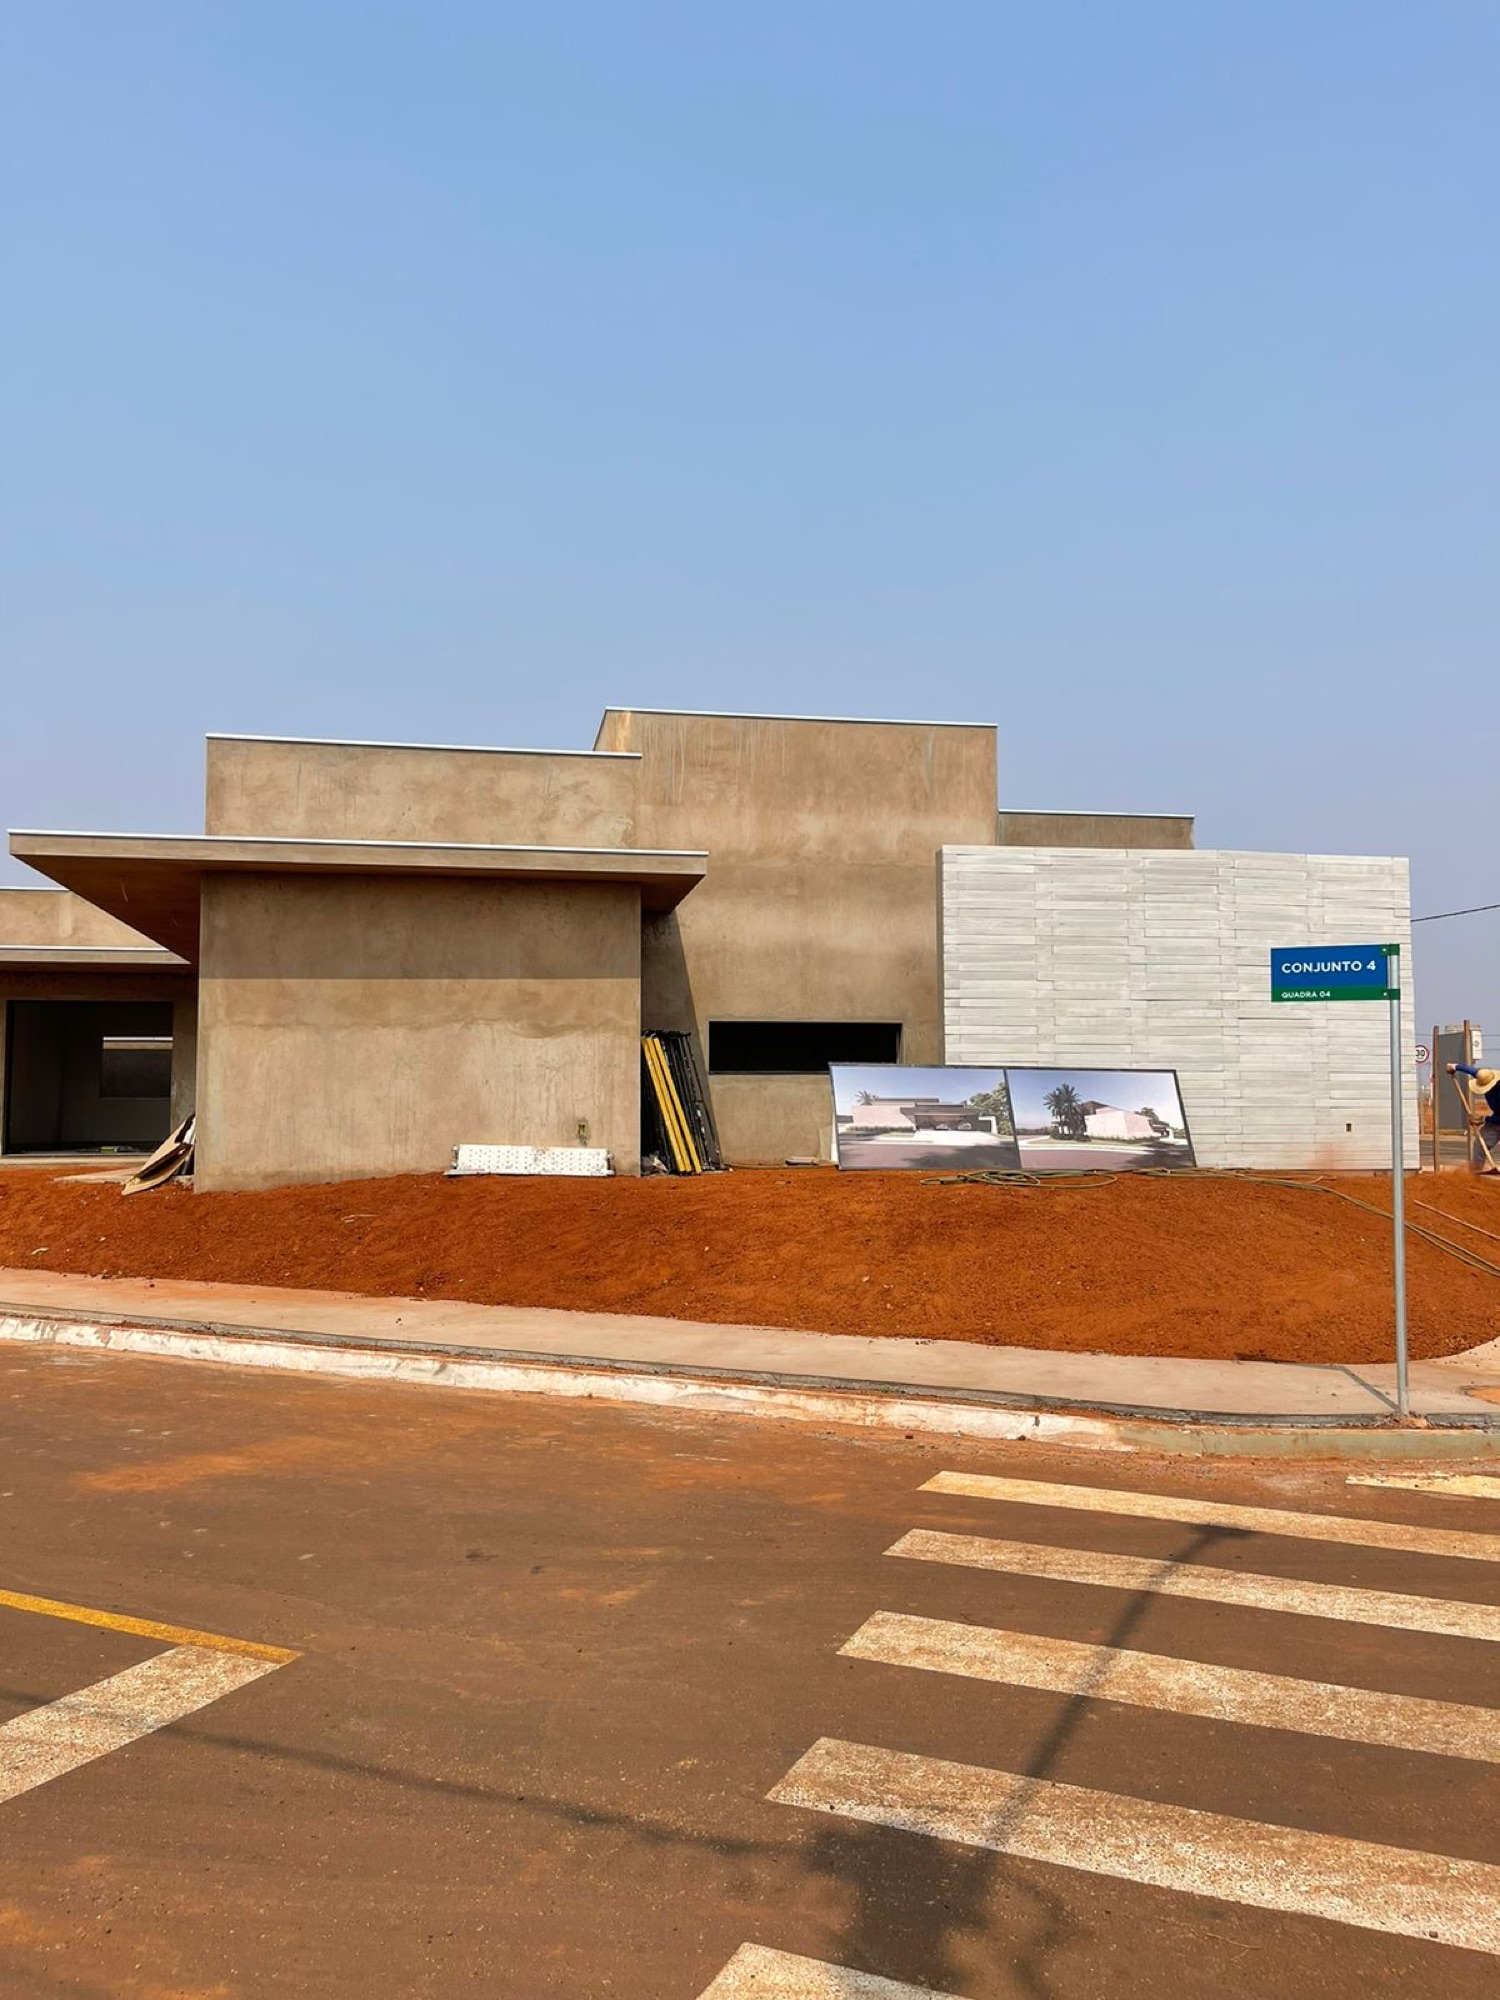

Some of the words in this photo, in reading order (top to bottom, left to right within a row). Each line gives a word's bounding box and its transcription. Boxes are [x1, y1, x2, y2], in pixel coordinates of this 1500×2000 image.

[1281, 960, 1362, 973] CONJUNTO
[1366, 960, 1377, 971] 4
[1281, 991, 1318, 999] QUADRA
[1319, 990, 1331, 998] 04
